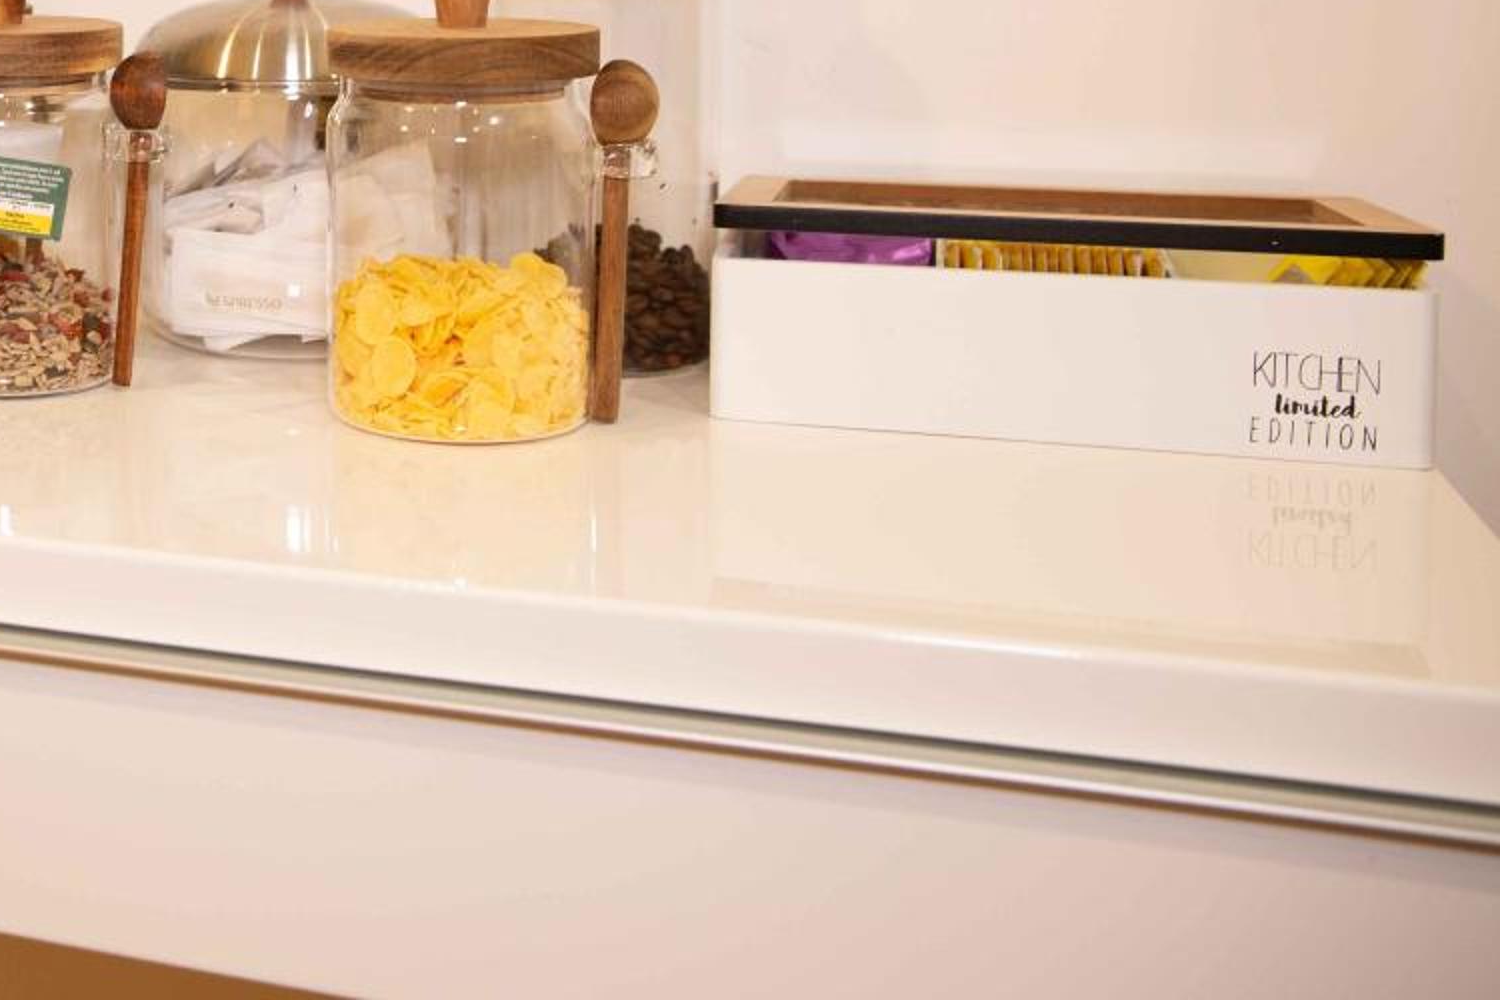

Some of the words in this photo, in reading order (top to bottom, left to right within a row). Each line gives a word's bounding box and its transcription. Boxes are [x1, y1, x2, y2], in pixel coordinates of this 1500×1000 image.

[1252, 350, 1381, 395] KITCHEN
[1274, 393, 1362, 420] limited
[1250, 417, 1377, 451] EDITION
